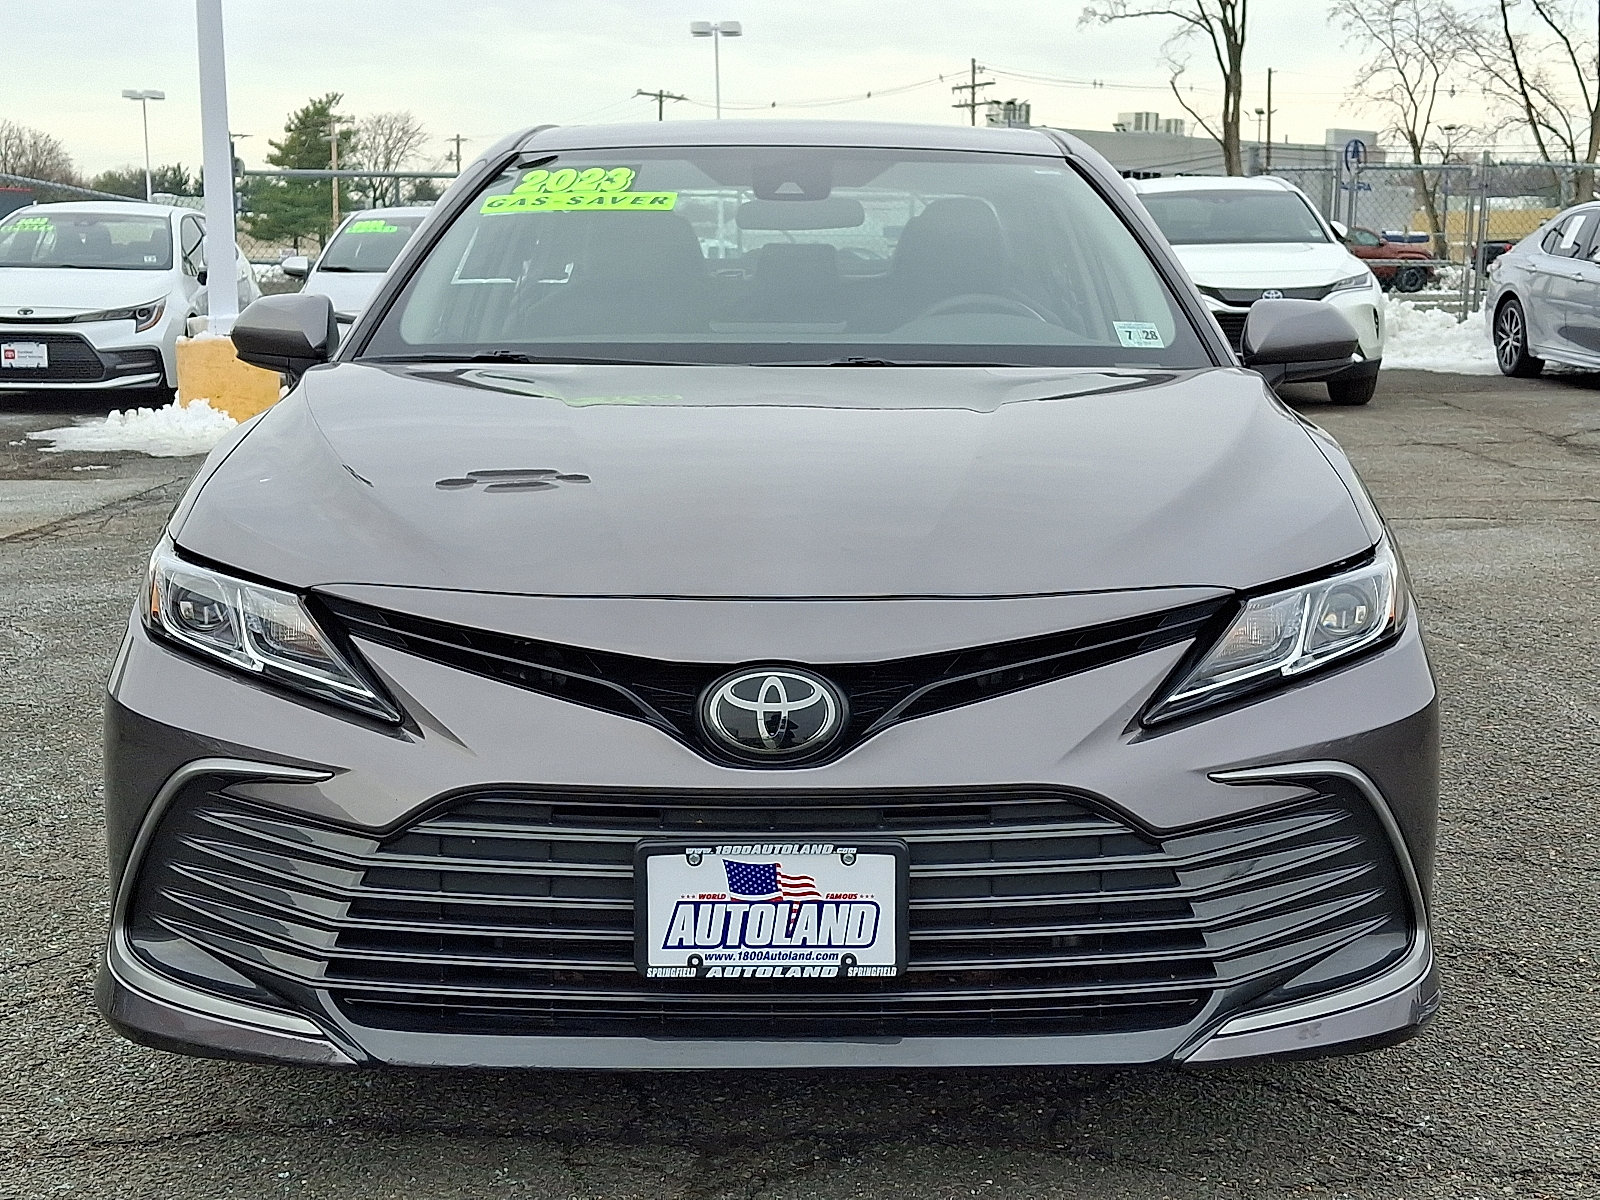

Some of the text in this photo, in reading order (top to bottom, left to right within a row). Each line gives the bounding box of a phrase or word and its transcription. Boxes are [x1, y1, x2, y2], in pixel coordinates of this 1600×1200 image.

[512, 167, 636, 193] 2023
[1124, 330, 1158, 340] 7 28
[662, 902, 880, 949] AUTOLAND
[704, 951, 839, 961] www.1800Autoland.com
[646, 966, 897, 978] SPRINGFIELD AUTOLAND SPRINGFIELD
